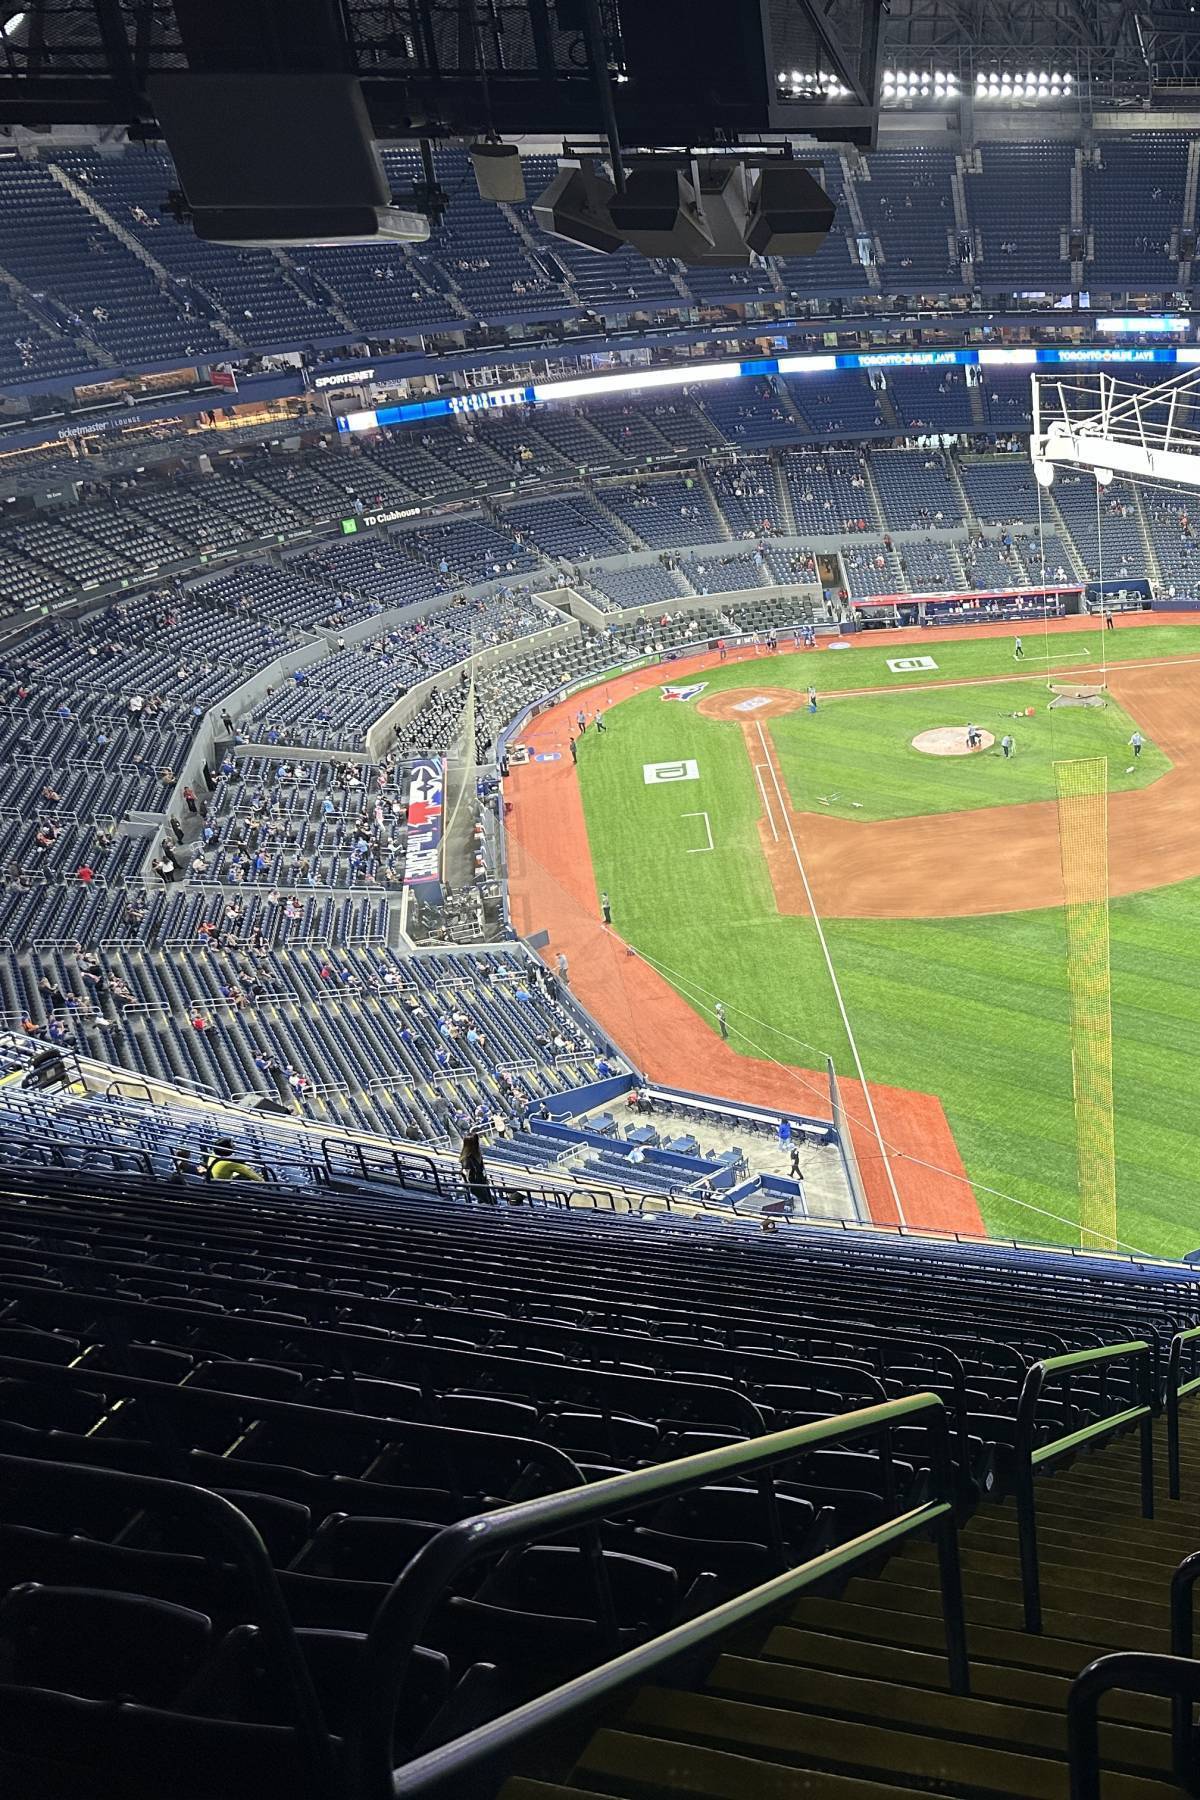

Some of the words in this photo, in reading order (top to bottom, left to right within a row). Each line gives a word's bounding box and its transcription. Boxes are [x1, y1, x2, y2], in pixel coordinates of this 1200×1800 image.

[1058, 351, 1102, 361] TORONTO
[1133, 350, 1154, 361] JAYS
[315, 369, 375, 388] SPORTSNET
[58, 422, 107, 439] ticketmaster
[114, 416, 141, 427] LOUNGE
[363, 516, 377, 527] TD
[377, 507, 421, 523] Clubhouse
